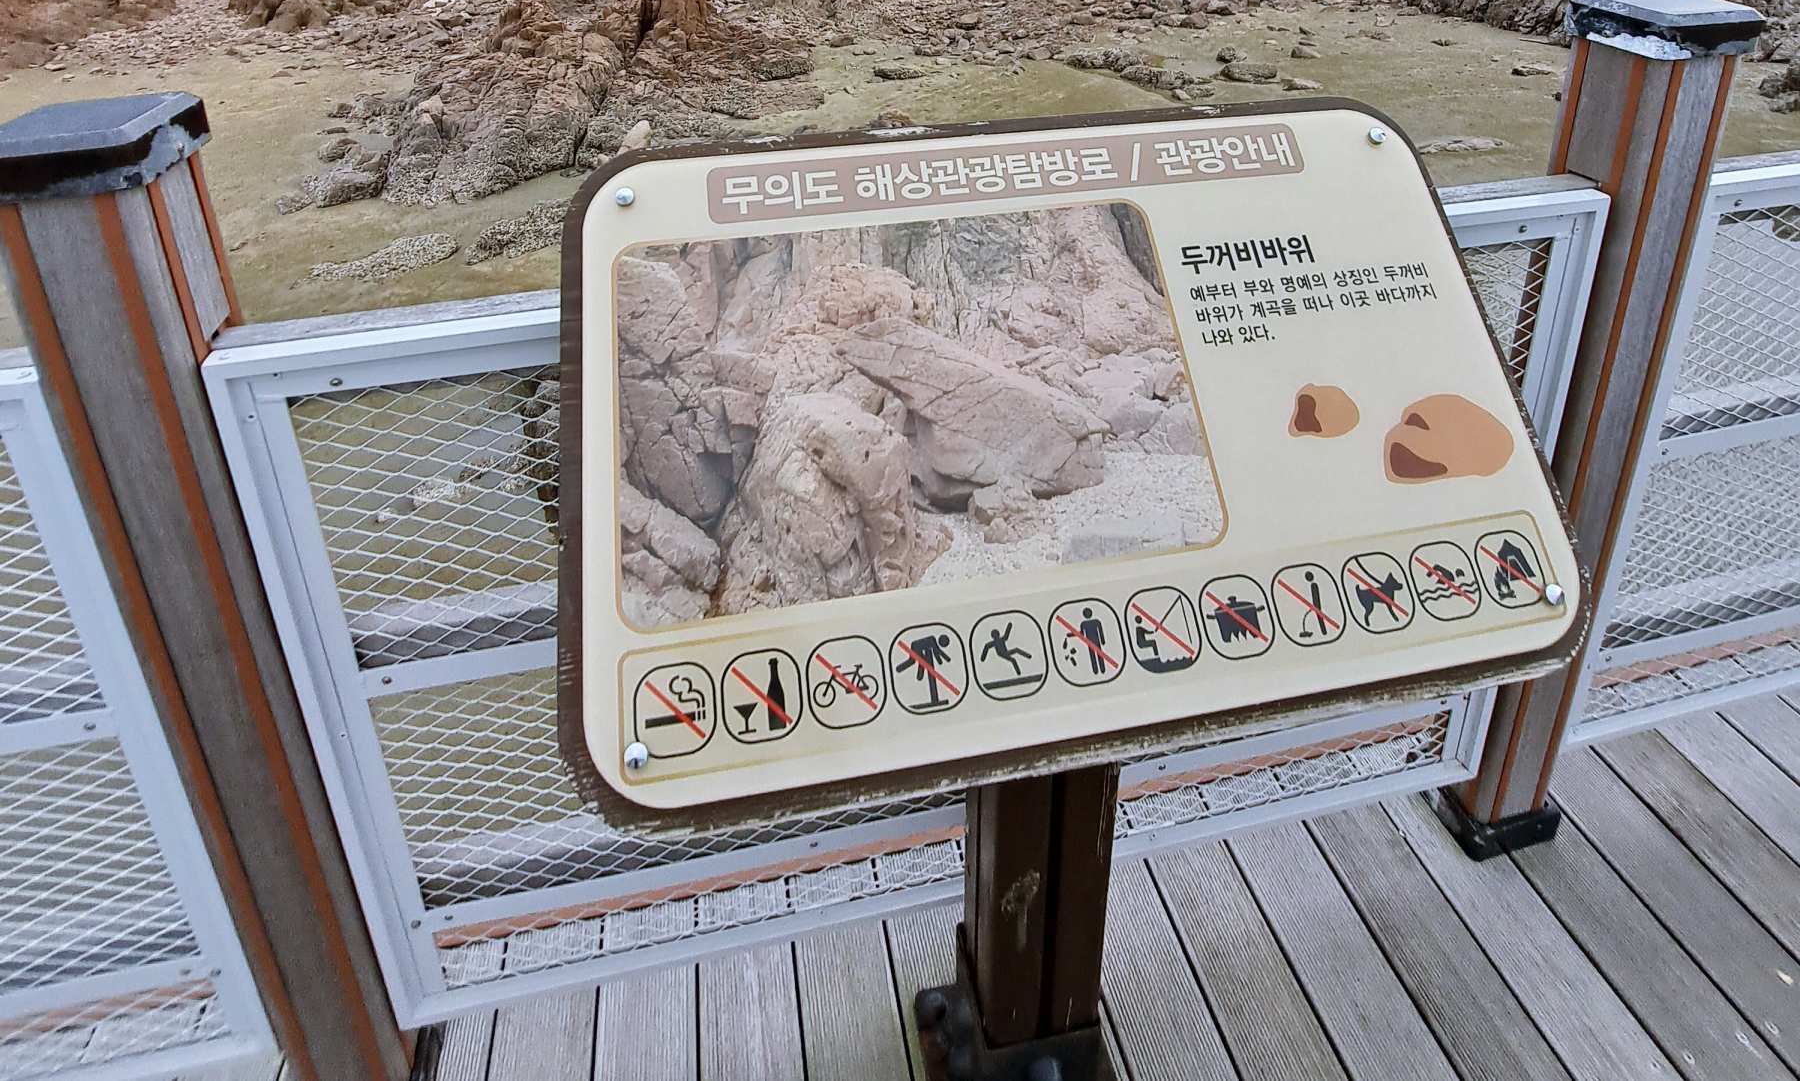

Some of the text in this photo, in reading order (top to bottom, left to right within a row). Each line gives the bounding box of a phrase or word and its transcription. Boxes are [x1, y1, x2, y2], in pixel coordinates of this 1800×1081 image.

[721, 132, 1294, 214] 무의도 해상관광탐방로 / 관광안내
[1181, 234, 1316, 274] 두꺼비바위
[1190, 262, 1429, 303] 예부터 부와 명예의 상징인 두꺼비
[1195, 282, 1438, 324] 바위가 계곡을 떠나 이곳 바다까지
[1202, 324, 1276, 347] 나와 있다.
